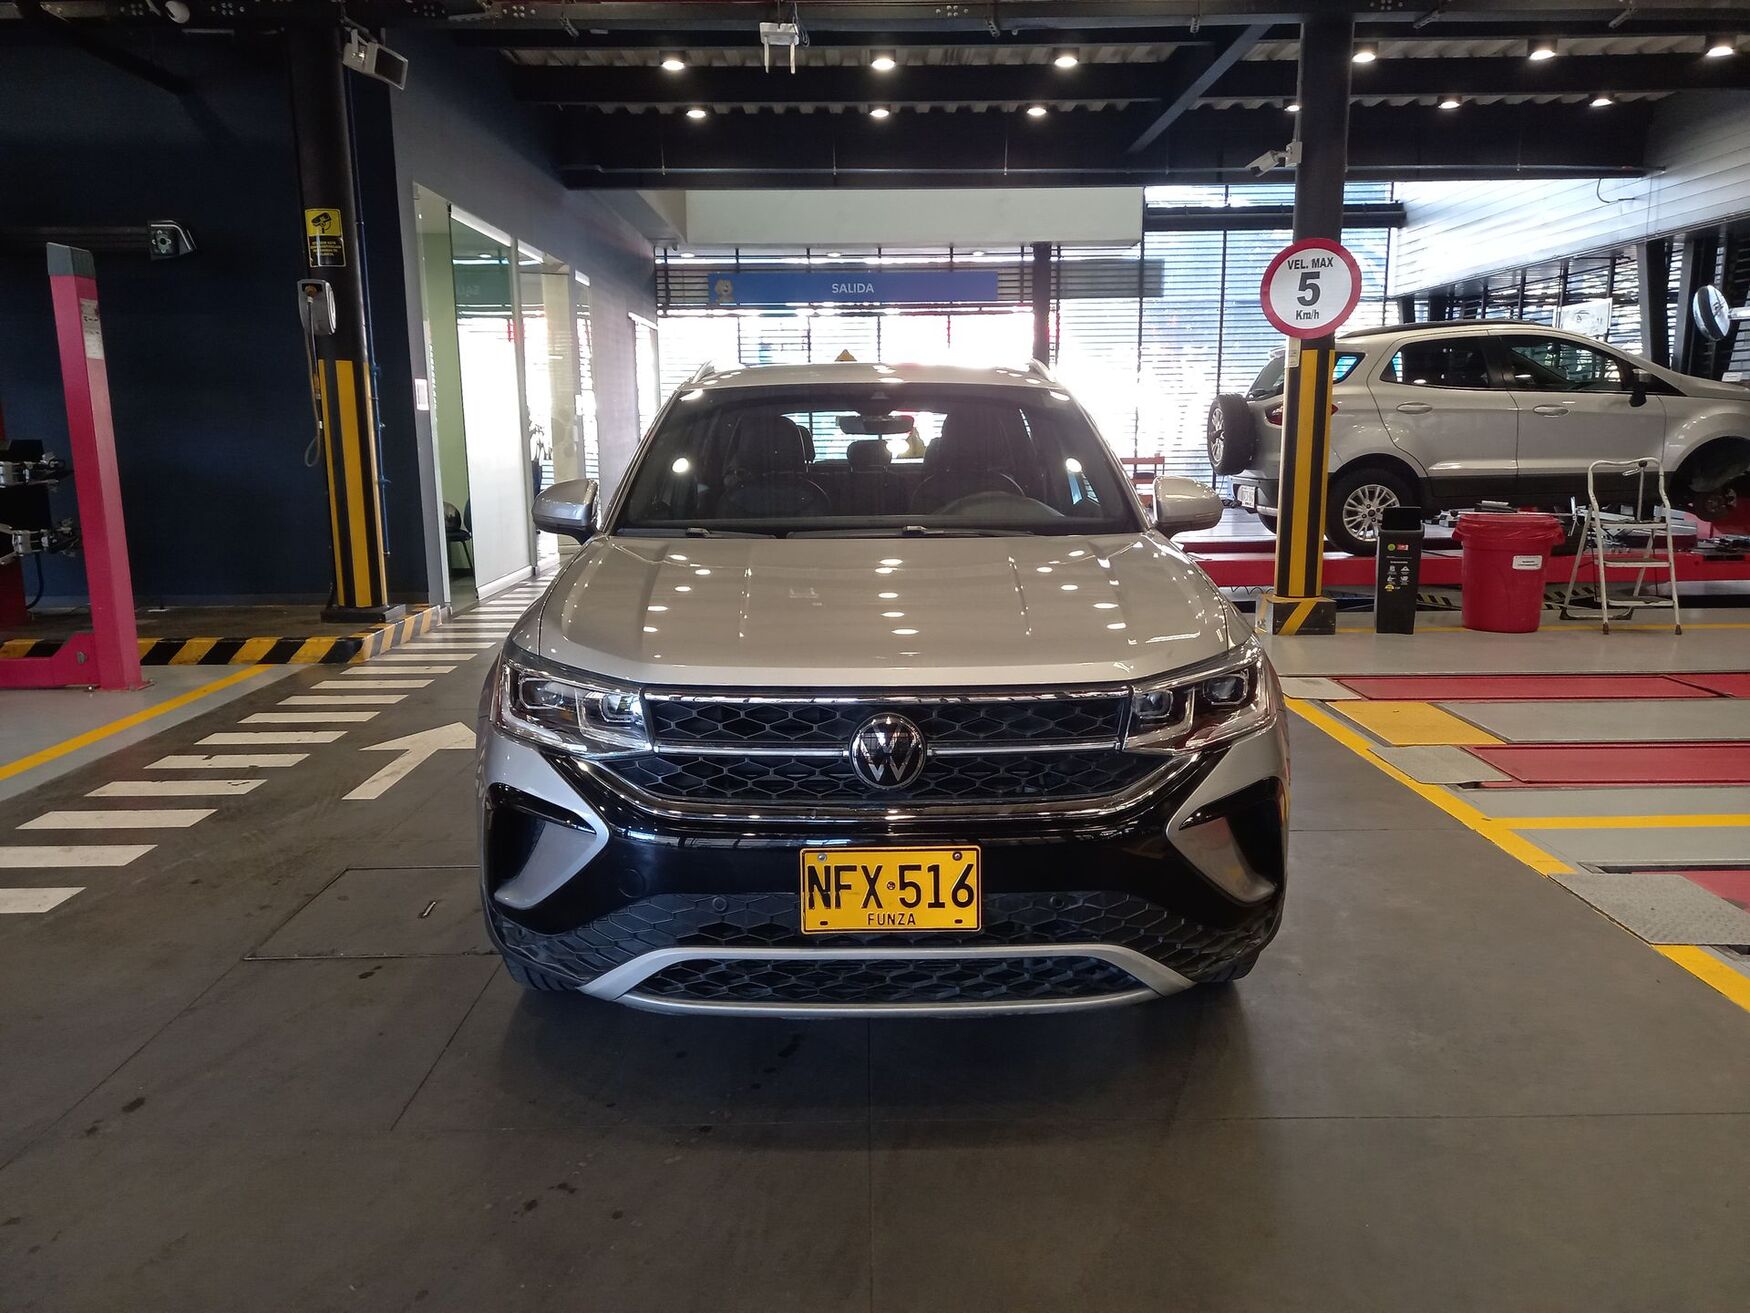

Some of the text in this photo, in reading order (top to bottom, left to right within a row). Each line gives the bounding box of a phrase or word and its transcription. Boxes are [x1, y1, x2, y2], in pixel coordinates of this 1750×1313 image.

[1287, 257, 1334, 270] VEL. MAX
[831, 283, 875, 294] SALIDA
[1296, 270, 1321, 307] 5
[1295, 310, 1320, 320] Km/h
[867, 913, 916, 926] FUNZA
